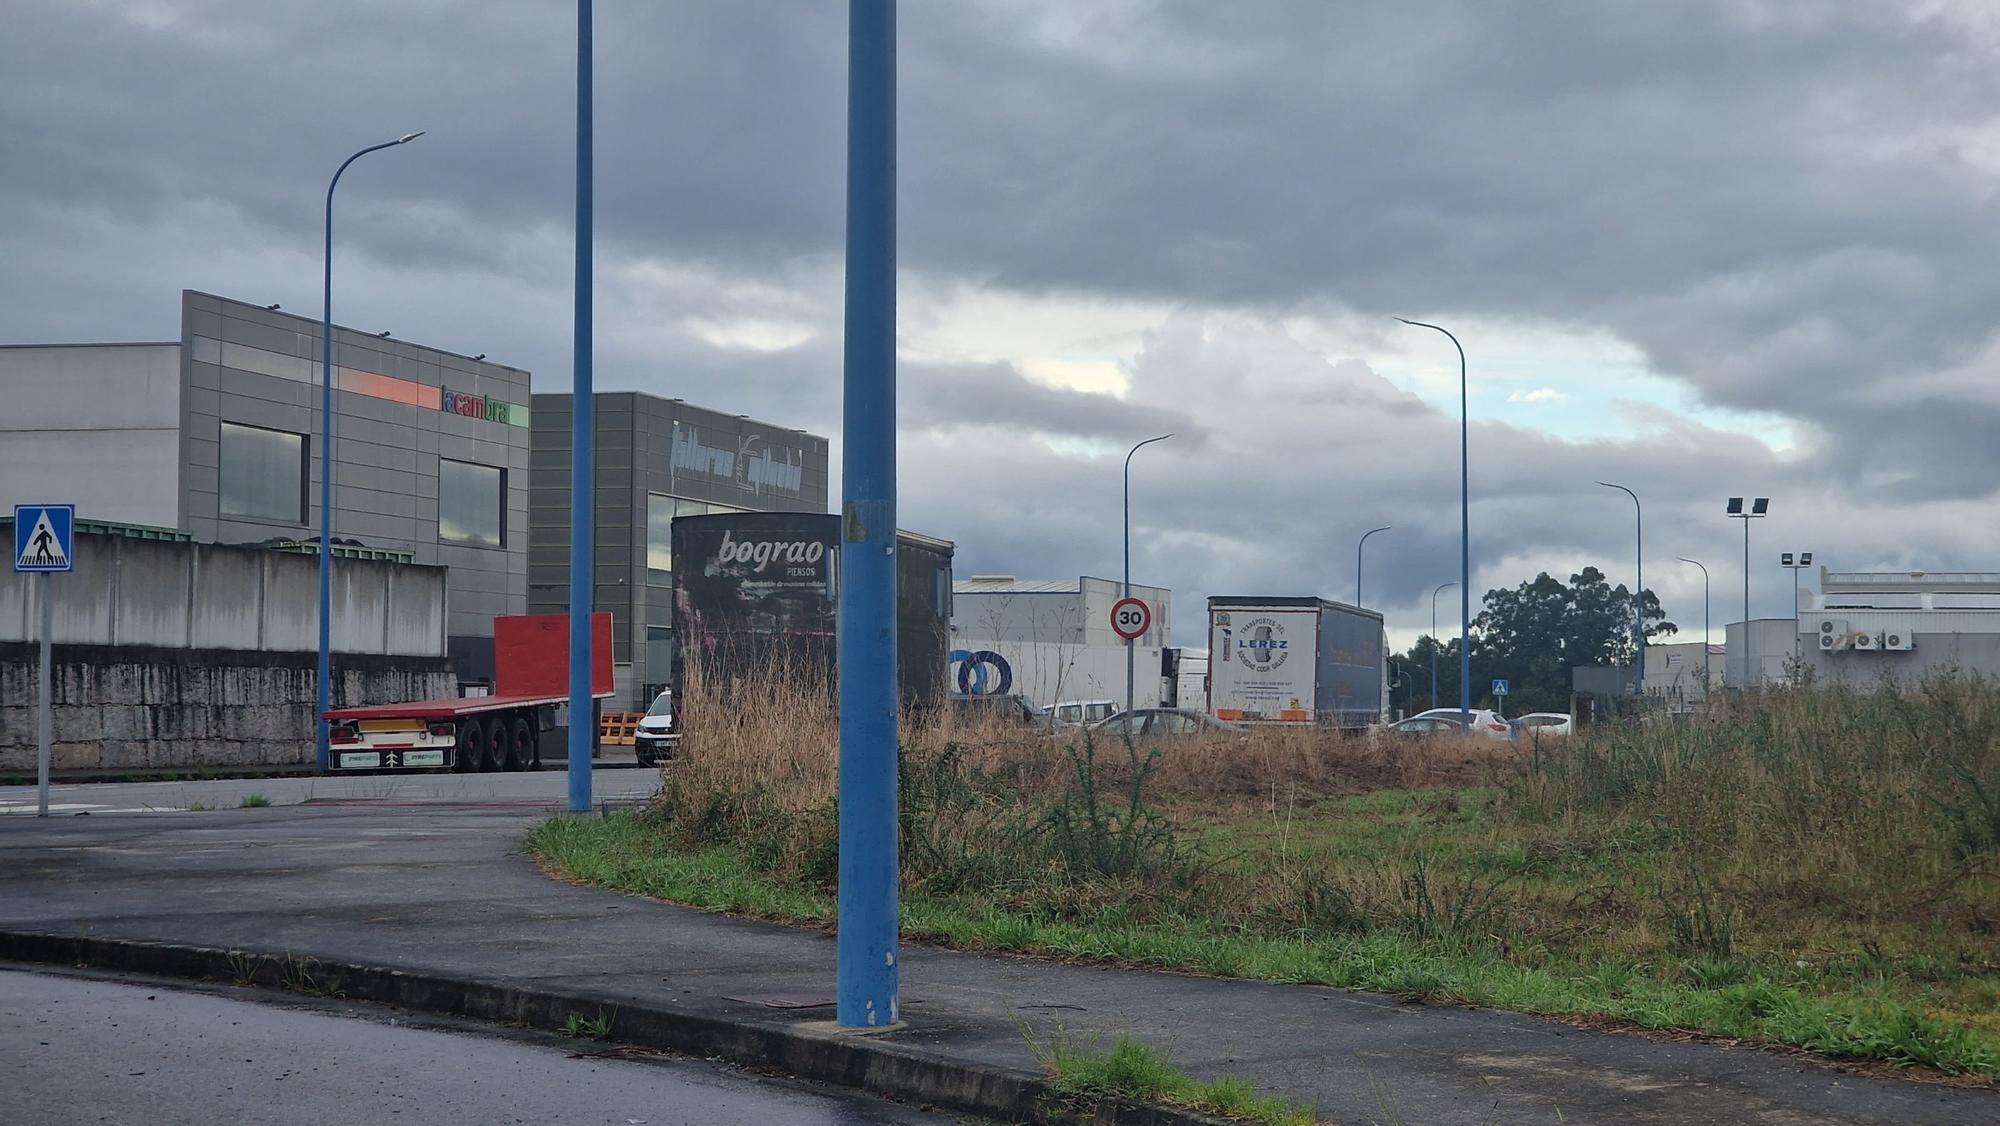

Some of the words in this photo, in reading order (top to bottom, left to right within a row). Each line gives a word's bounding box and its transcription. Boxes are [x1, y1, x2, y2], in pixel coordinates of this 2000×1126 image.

[442, 385, 510, 424] lacambra
[719, 530, 824, 573] bograo
[787, 567, 816, 577] PIENSOS
[1119, 611, 1142, 625] 30
[1239, 639, 1288, 649] LEREZ
